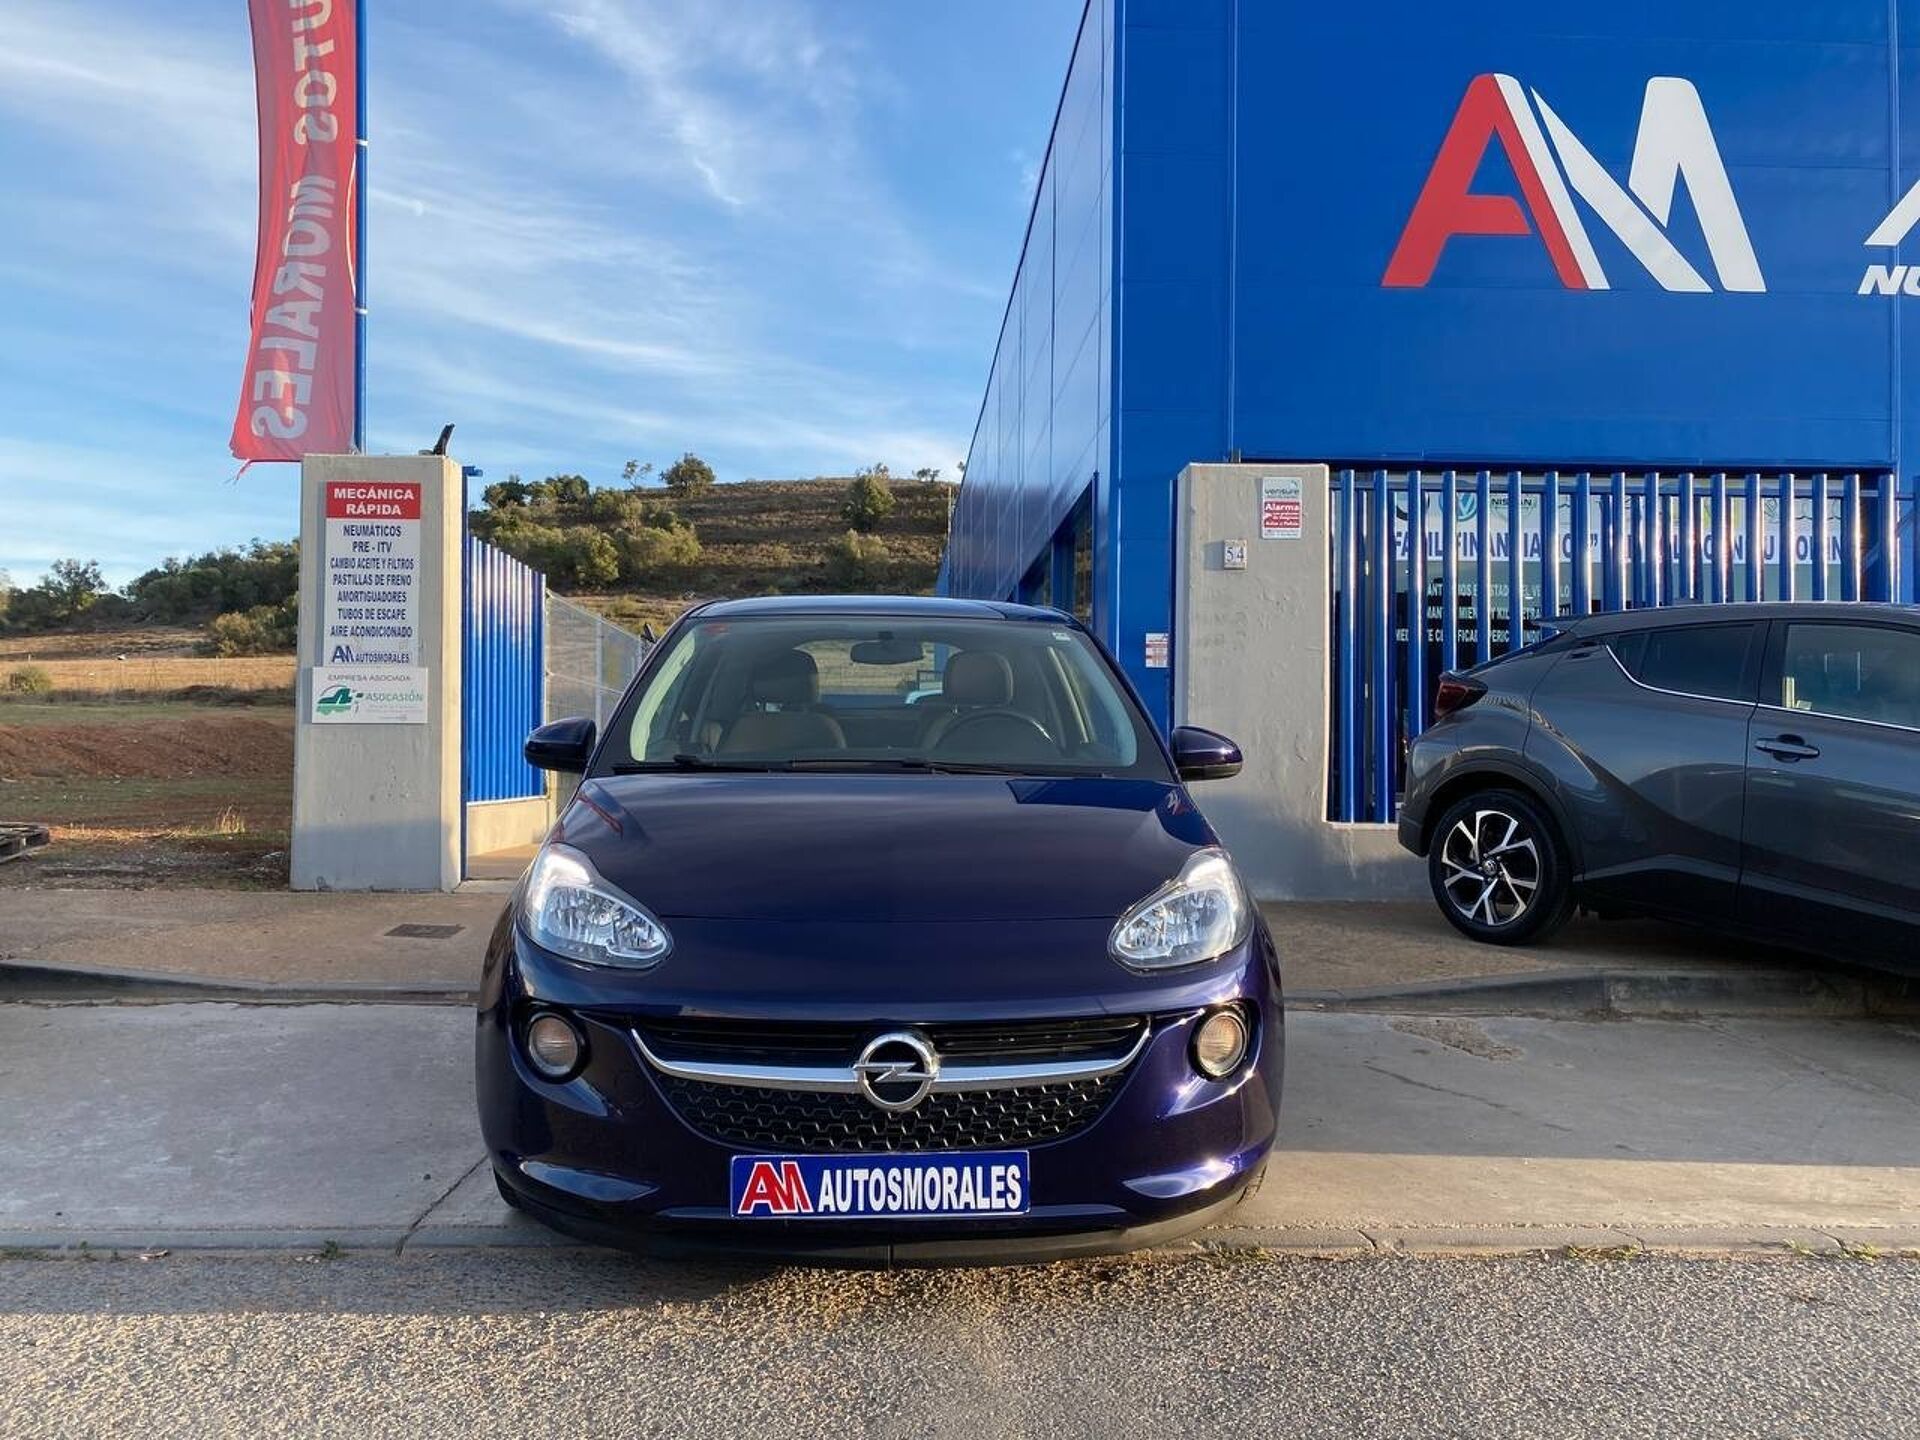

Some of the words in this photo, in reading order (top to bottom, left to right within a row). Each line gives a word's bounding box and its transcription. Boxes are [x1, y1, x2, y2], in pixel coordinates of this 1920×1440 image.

[1382, 73, 1767, 292] AM
[334, 486, 414, 500] MECÁNICA
[346, 501, 402, 515] RÁPIDA
[1265, 503, 1299, 511] Alarma
[352, 541, 370, 552] PRE
[377, 541, 392, 552] ITV
[1226, 546, 1245, 562] 54
[330, 558, 356, 569] CAMBIO
[357, 558, 381, 569] ACEITE
[387, 558, 414, 570] FILTROS
[333, 574, 373, 586] PASTILLAS
[375, 574, 386, 586] DE
[387, 574, 412, 586] FRENO
[337, 591, 407, 602] AMORTIGUADORES
[338, 608, 364, 620] TUBOS
[365, 608, 376, 620] DE
[377, 608, 406, 620] ESCAPE
[330, 626, 349, 637] AIRE
[350, 626, 413, 637] ACONDICIONADO
[356, 653, 410, 663] AUTOSMORALES
[818, 1165, 1022, 1212] AUTOSMORALES
